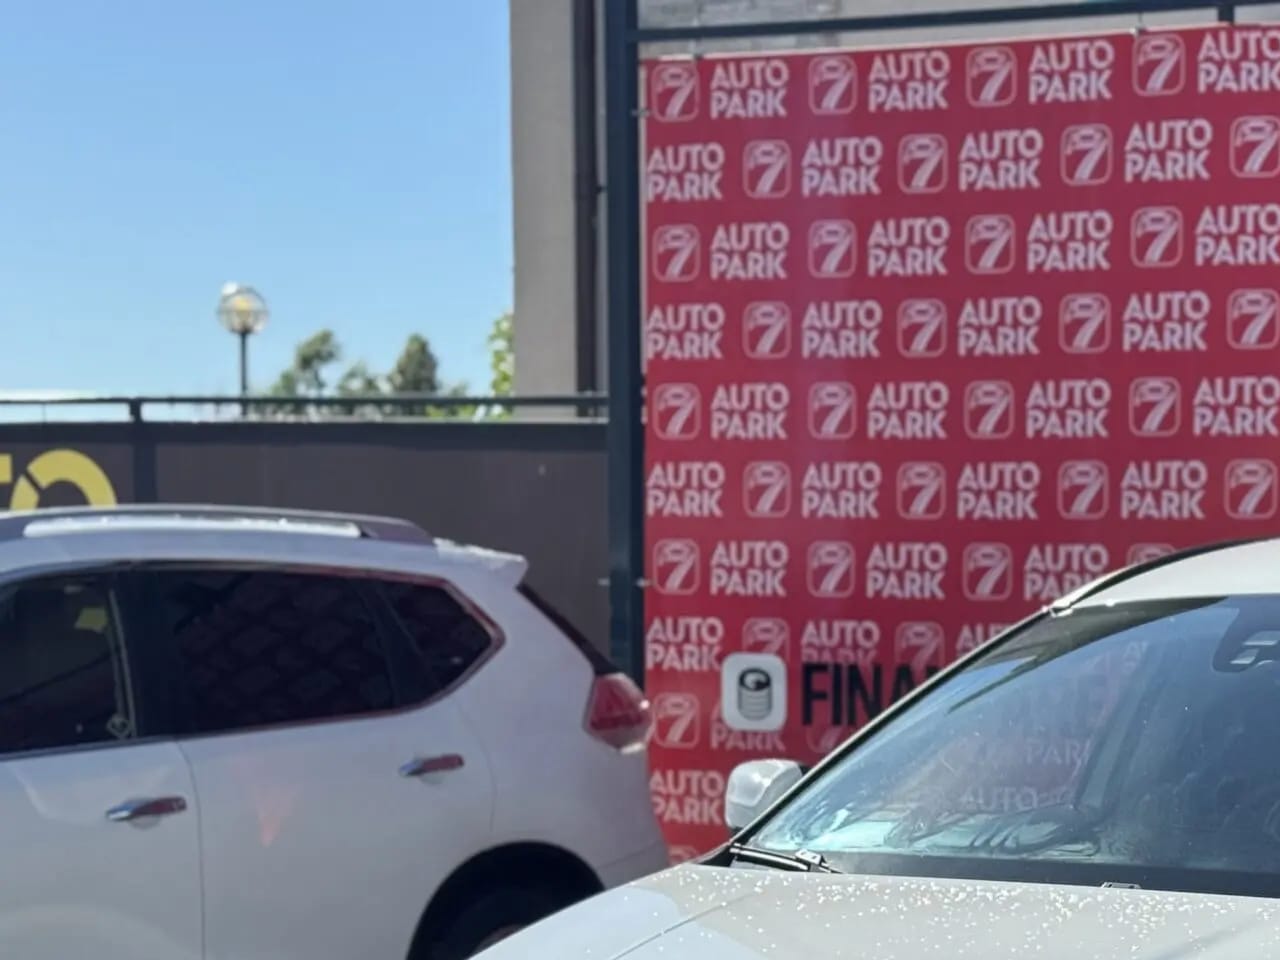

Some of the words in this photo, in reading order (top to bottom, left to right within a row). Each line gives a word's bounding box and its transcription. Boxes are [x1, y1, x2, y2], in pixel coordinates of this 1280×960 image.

[869, 52, 950, 82] AUTO
[1029, 42, 1114, 73] AUTO
[711, 61, 789, 91] AUTO
[1029, 71, 1111, 104] PARK
[711, 89, 786, 119] PARK
[869, 82, 947, 112] PARK
[959, 129, 1043, 161] AUTO
[1125, 119, 1212, 150] AUTO
[644, 144, 724, 173] AUTO
[802, 138, 882, 169] AUTO
[1125, 151, 1209, 181] PARK
[644, 173, 722, 202] PARK
[802, 167, 879, 198] PARK
[959, 159, 1040, 191] PARK
[711, 223, 789, 251] AUTO
[868, 217, 949, 246] AUTO
[1027, 211, 1113, 241] AUTO
[868, 246, 946, 275] PARK
[1028, 241, 1109, 271] PARK
[1196, 234, 1280, 266] PARK
[711, 252, 786, 280] PARK
[644, 304, 725, 333] AUTO
[802, 301, 882, 331] AUTO
[958, 297, 1042, 328] AUTO
[1123, 292, 1210, 323] AUTO
[644, 331, 722, 359] PARK
[802, 329, 879, 358] PARK
[958, 326, 1038, 356] PARK
[1123, 321, 1206, 352] PARK
[711, 384, 789, 412] AUTO
[868, 381, 949, 410] AUTO
[1026, 379, 1111, 410] AUTO
[711, 411, 786, 439] PARK
[868, 409, 946, 439] PARK
[1026, 408, 1108, 438] PARK
[1194, 406, 1278, 436] PARK
[646, 463, 725, 491] AUTO
[802, 462, 881, 491] AUTO
[958, 462, 1040, 490] AUTO
[1121, 461, 1207, 491] AUTO
[647, 489, 722, 517] PARK
[802, 489, 878, 519] PARK
[957, 490, 1037, 519] PARK
[1121, 489, 1204, 519] PARK
[711, 542, 788, 568] AUTO
[867, 544, 947, 570] AUTO
[1025, 545, 1108, 574] AUTO
[710, 569, 785, 596] PARK
[866, 570, 944, 599] PARK
[646, 618, 723, 645] AUTO
[801, 621, 880, 647] AUTO
[647, 644, 722, 672] PARK
[651, 771, 723, 798] AUTO
